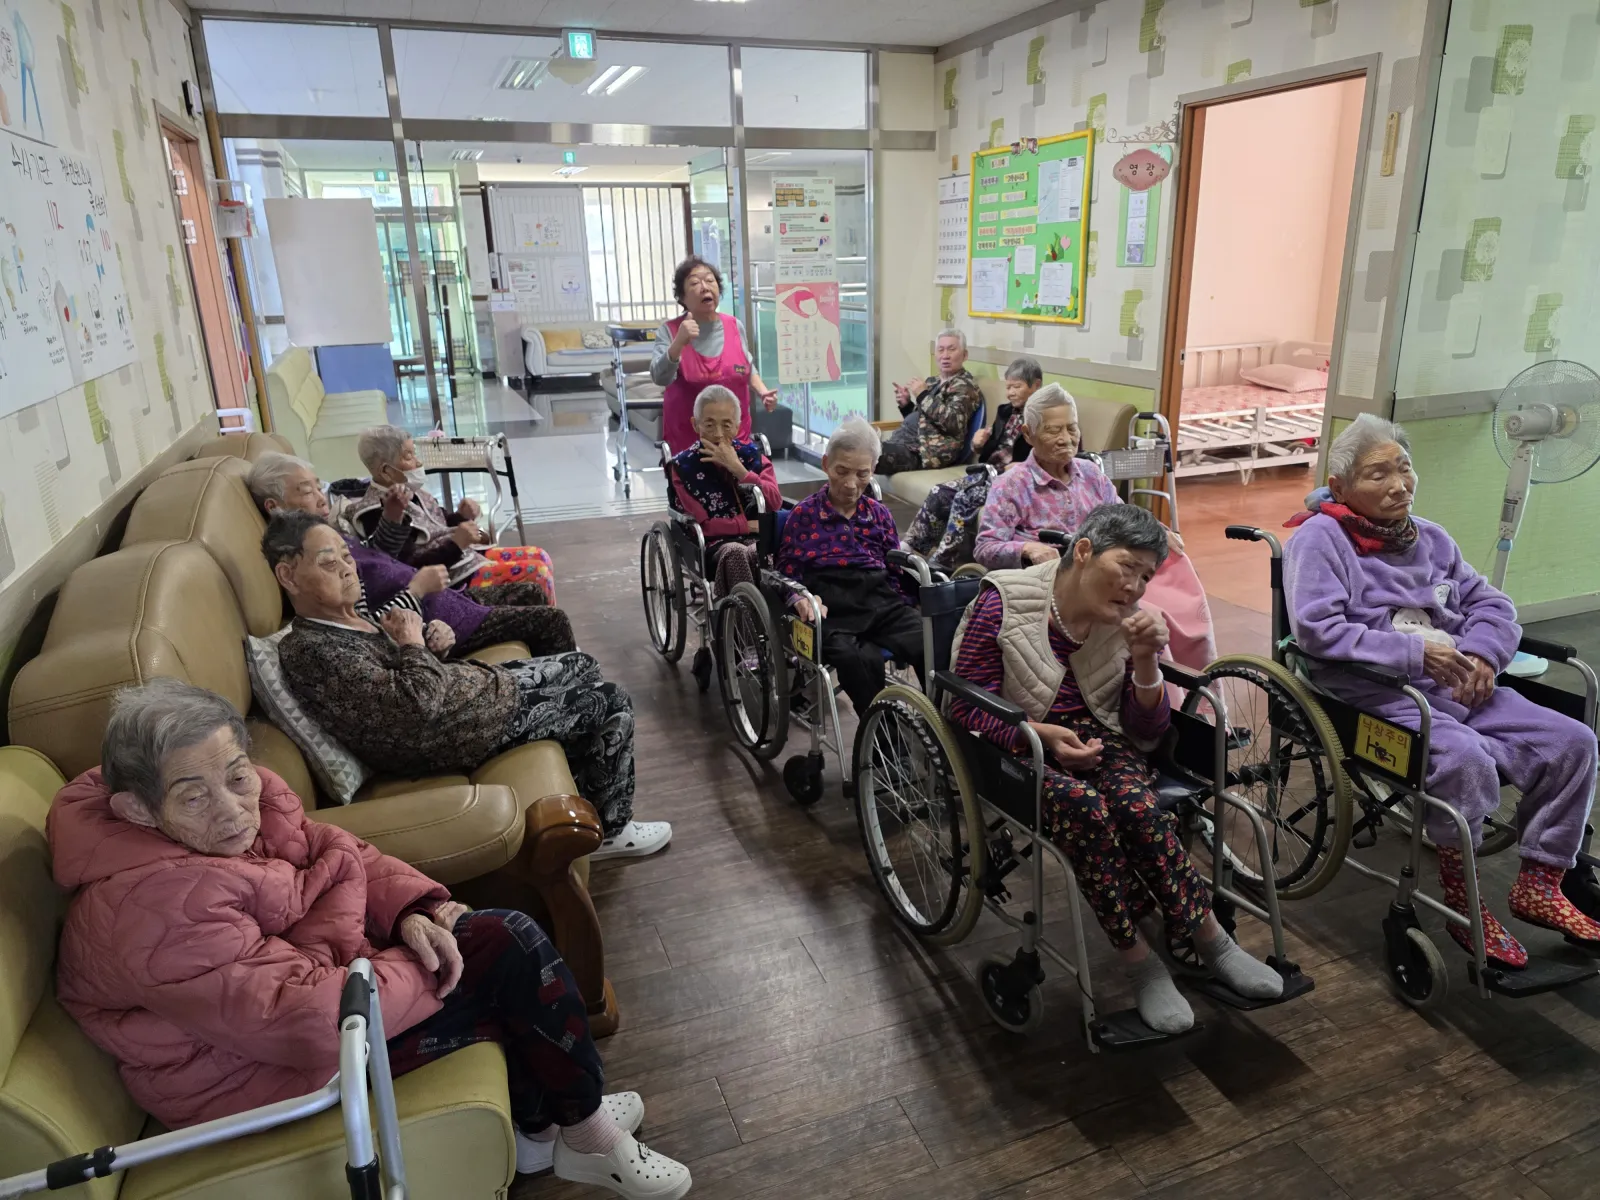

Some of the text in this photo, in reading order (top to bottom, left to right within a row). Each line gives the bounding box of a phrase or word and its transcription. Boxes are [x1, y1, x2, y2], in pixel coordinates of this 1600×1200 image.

[11, 141, 53, 185] 수사기관
[46, 199, 65, 231] 112
[1363, 719, 1408, 749] 낙상주의
